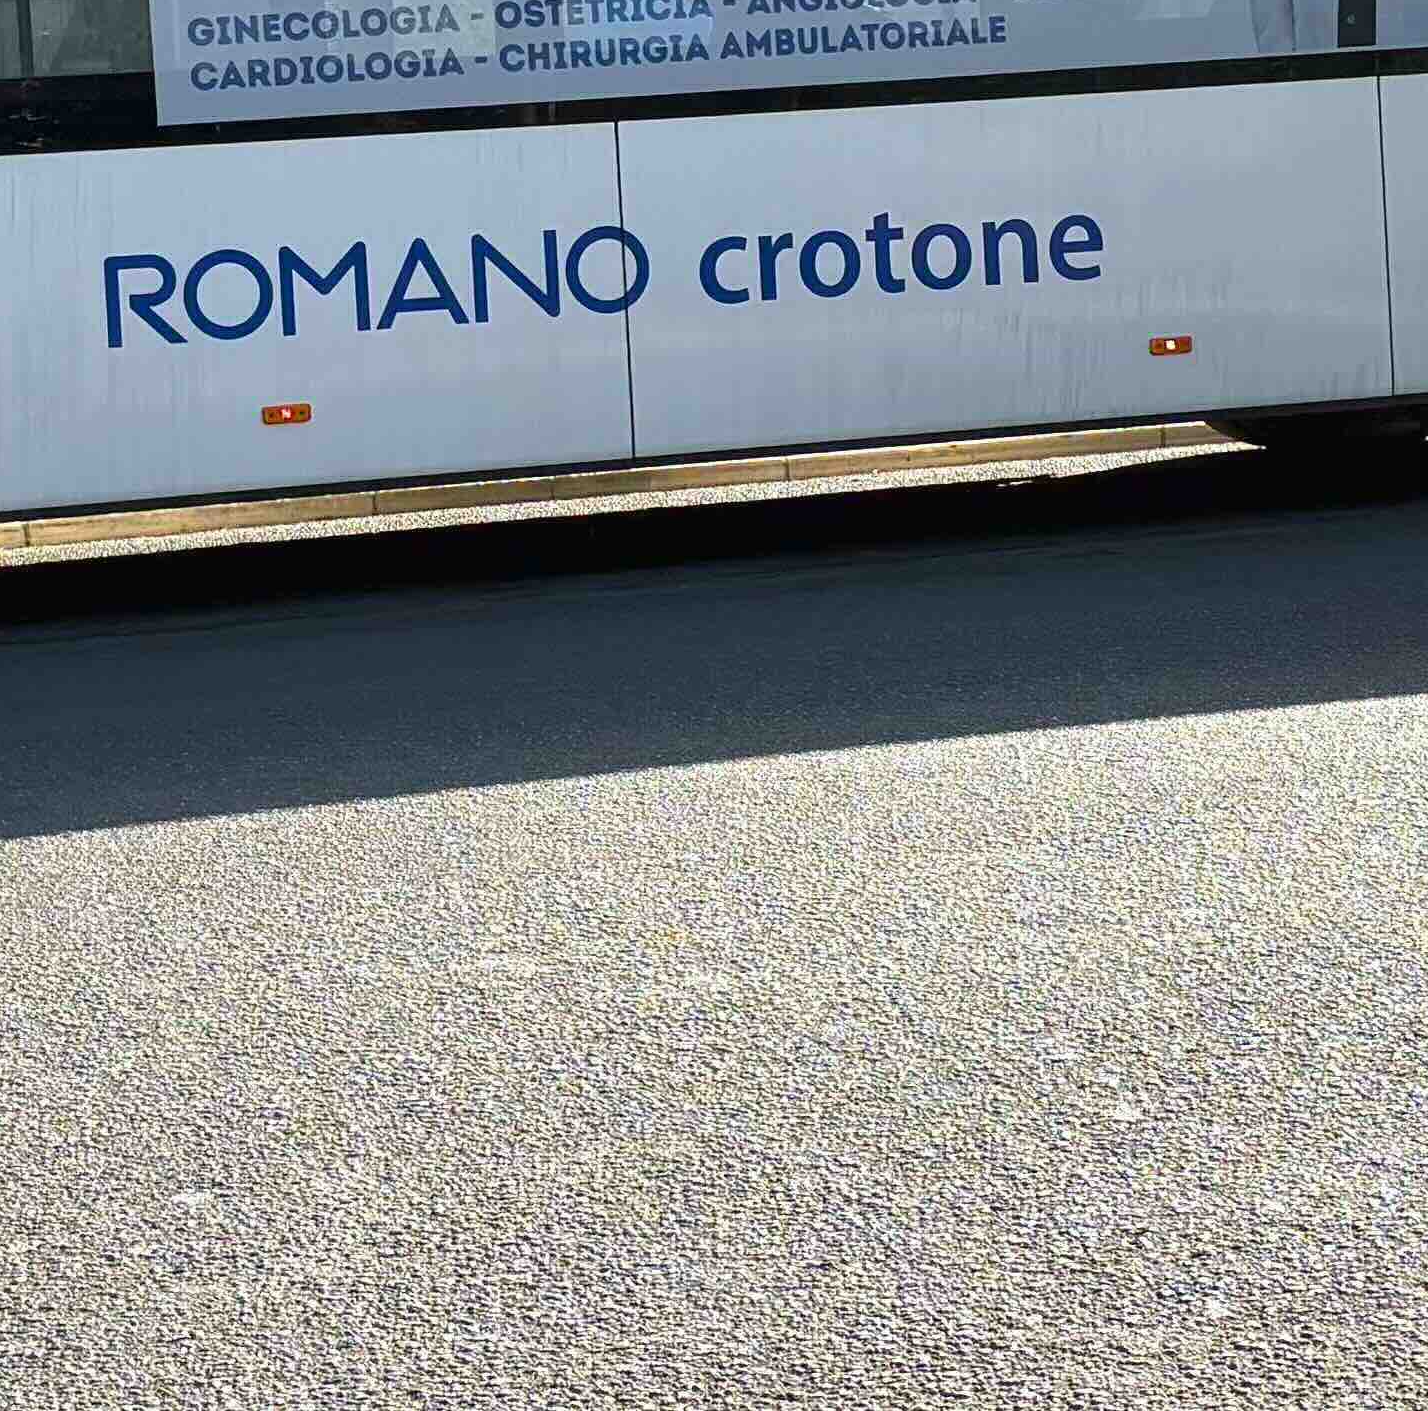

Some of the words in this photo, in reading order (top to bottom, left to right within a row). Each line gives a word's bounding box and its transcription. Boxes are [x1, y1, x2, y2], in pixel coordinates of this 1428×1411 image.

[188, 6, 459, 46] GINECOLOGIA
[190, 49, 465, 91] CARDIOLOGIA
[499, 34, 710, 73] CHIRURGIA
[720, 16, 1007, 58] AMBULATORIALE
[103, 225, 649, 349] ROMANO
[699, 212, 1104, 305] crotone
